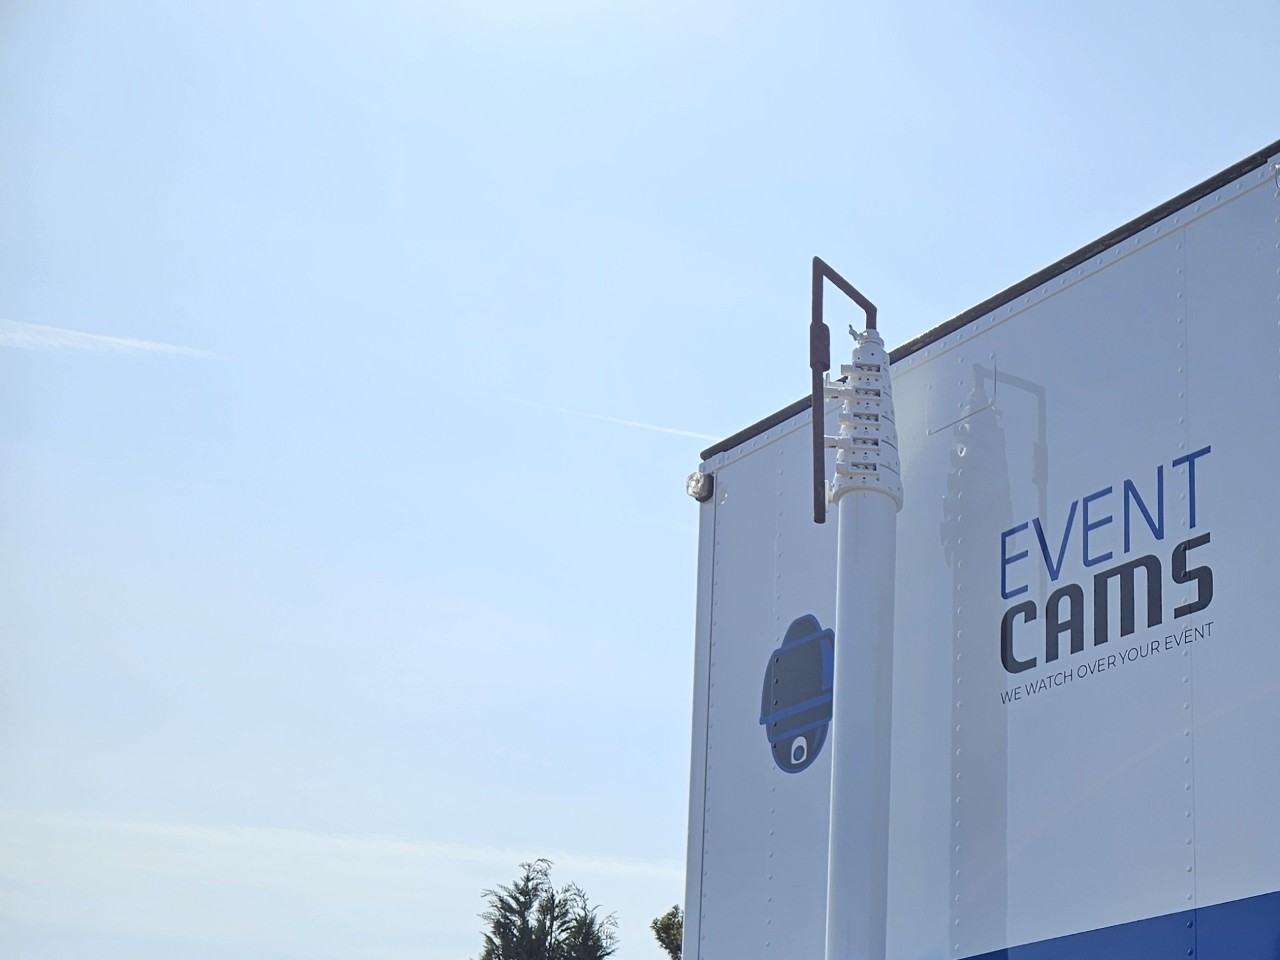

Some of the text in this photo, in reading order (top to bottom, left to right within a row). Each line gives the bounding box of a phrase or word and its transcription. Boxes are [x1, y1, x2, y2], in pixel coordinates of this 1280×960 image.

[1001, 445, 1211, 600] EVENT
[1000, 531, 1214, 674] CAMS
[1000, 621, 1214, 705] WE WATCH OVER YOUR EVENT
